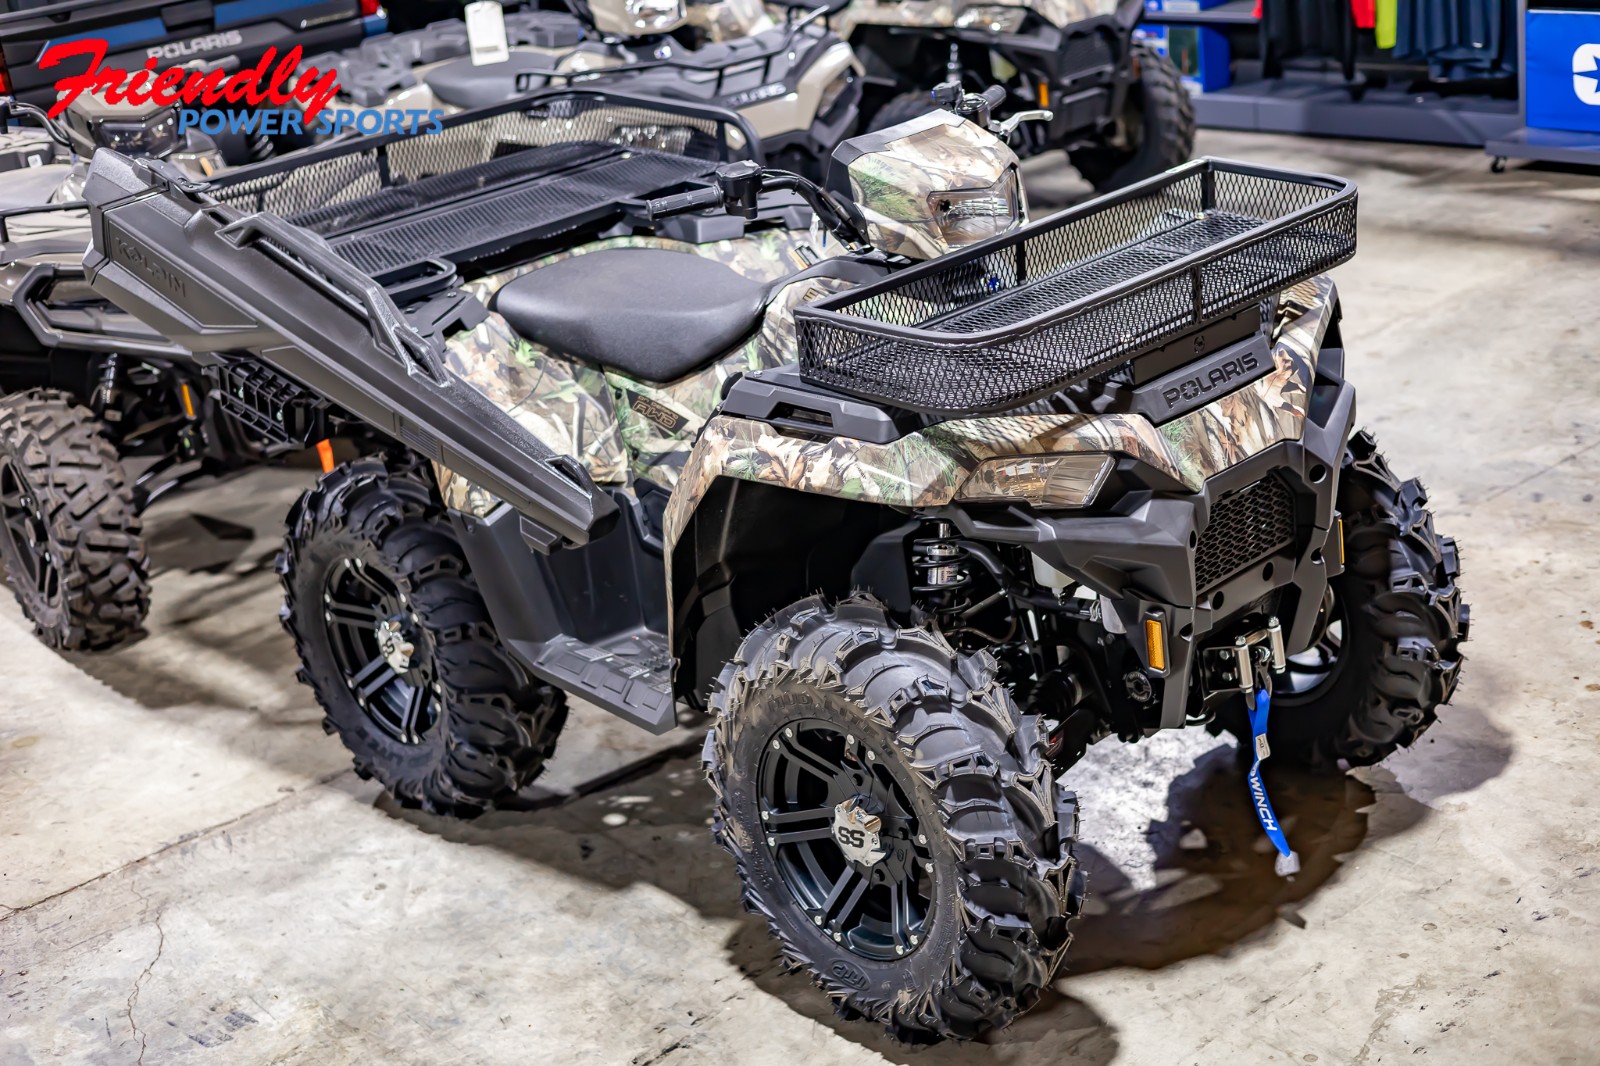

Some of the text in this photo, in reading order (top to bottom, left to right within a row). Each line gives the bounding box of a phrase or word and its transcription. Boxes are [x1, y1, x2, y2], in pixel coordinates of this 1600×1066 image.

[146, 30, 243, 59] POLARIS
[1163, 352, 1259, 411] POLARIS
[632, 400, 677, 429] AWD
[1250, 776, 1278, 831] WINCH
[838, 826, 865, 849] SS
